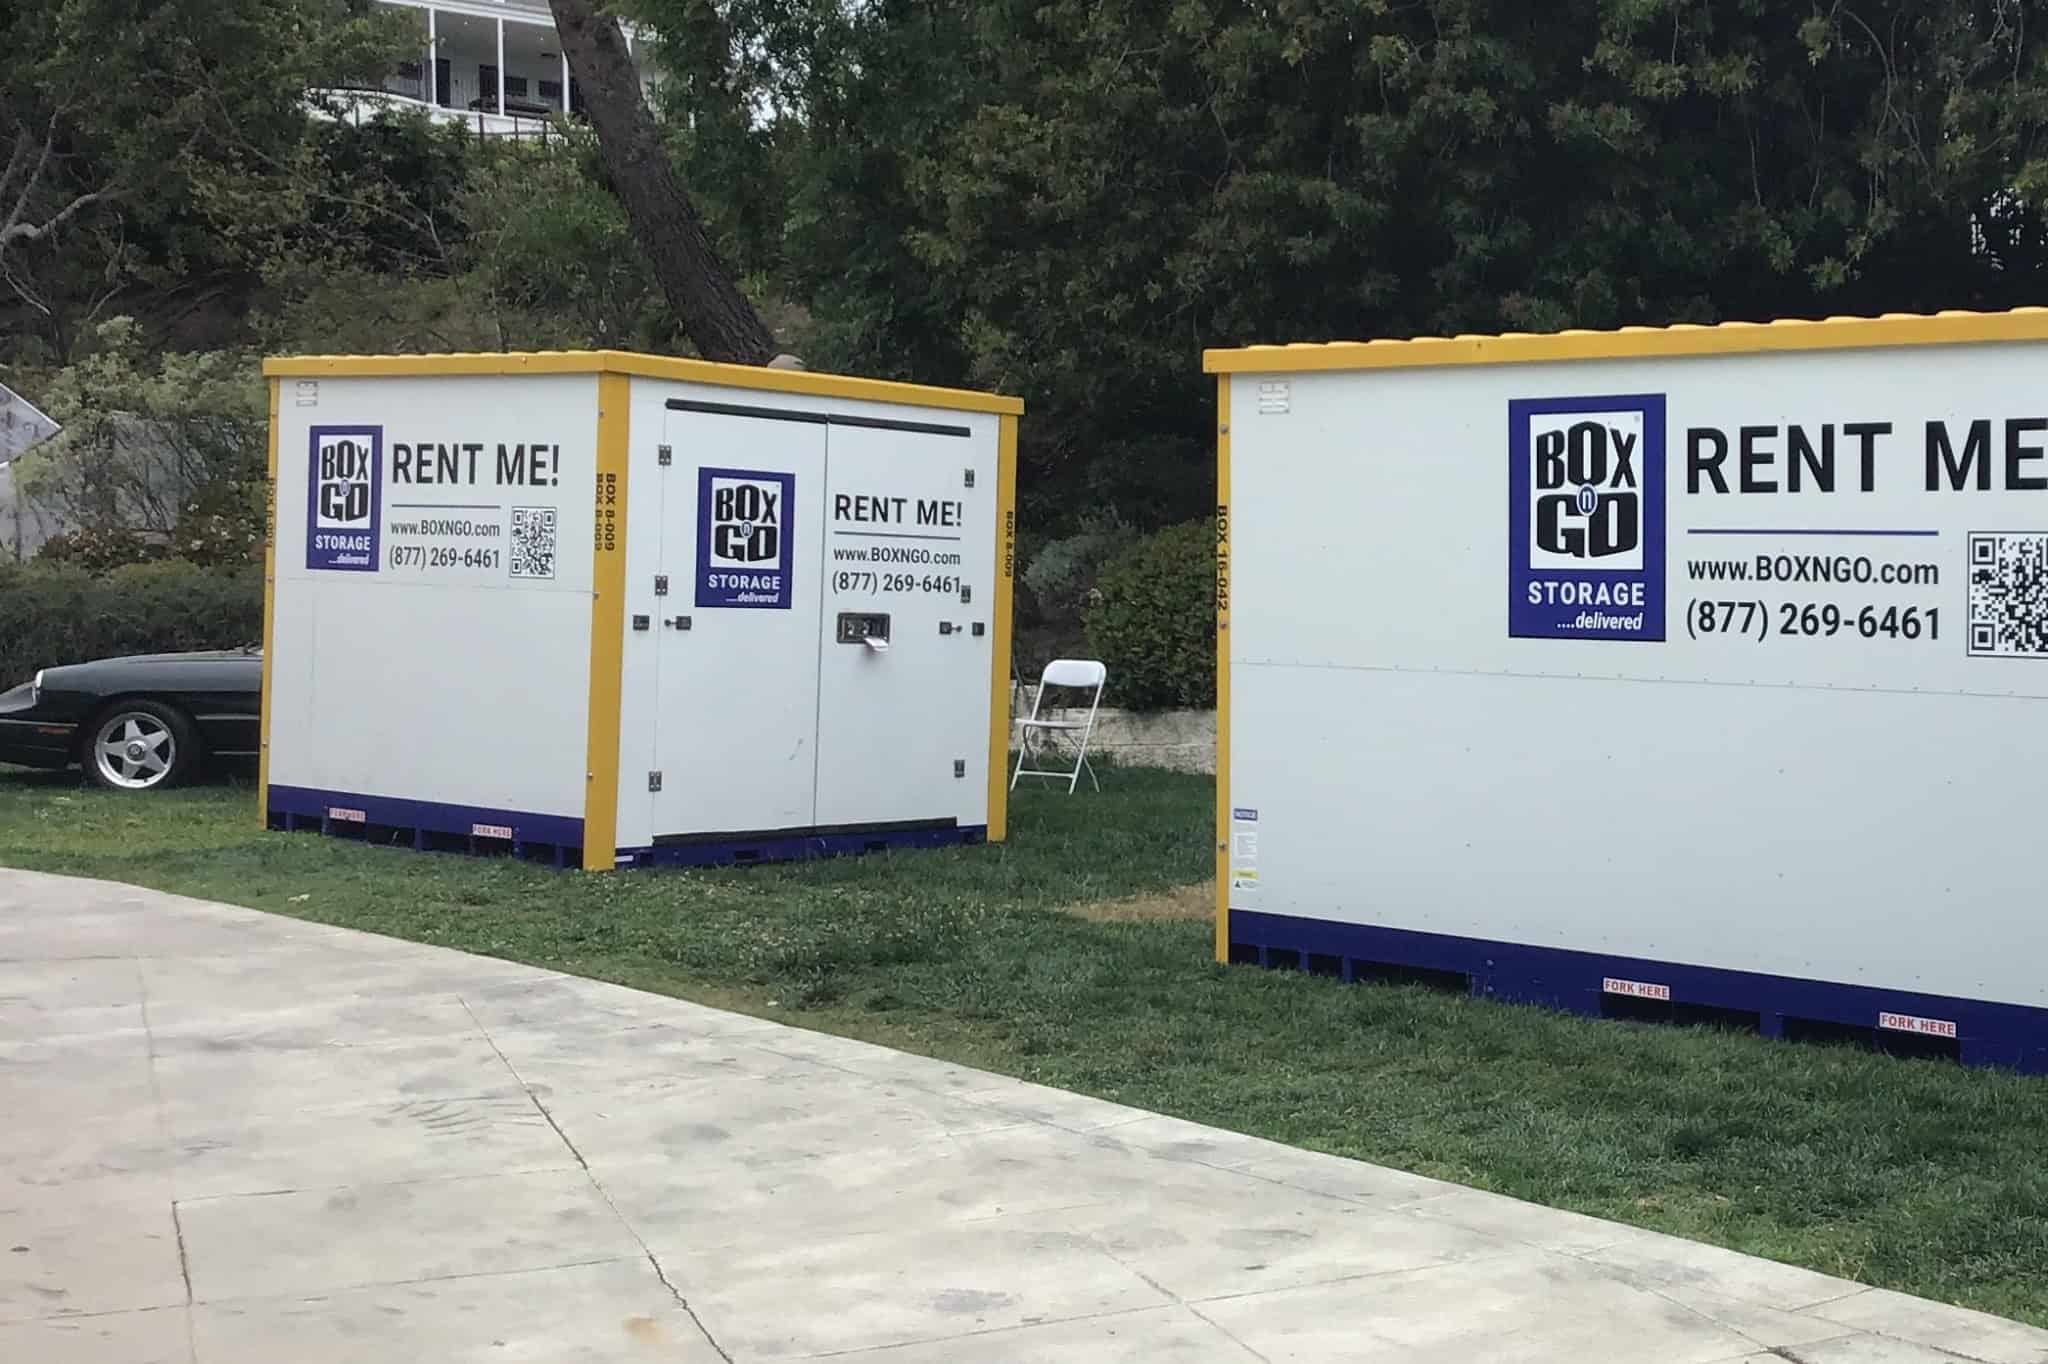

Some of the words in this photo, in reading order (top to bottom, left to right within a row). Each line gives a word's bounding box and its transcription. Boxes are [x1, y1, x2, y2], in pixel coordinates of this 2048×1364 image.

[320, 439, 369, 480] BOX
[392, 443, 484, 485] RENT
[496, 443, 560, 487] ME!
[1536, 420, 1638, 489] BOX
[1686, 421, 1892, 495] RENT
[1925, 417, 2048, 491] ME
[320, 483, 369, 522] GO
[605, 473, 617, 504] BOX
[715, 484, 777, 524] BOX
[834, 493, 908, 523] RENT
[916, 499, 963, 527] ME!
[1006, 511, 1014, 538] BOX
[1217, 504, 1228, 545] BOX
[1536, 491, 1638, 559] GO
[315, 535, 371, 551] STORAGE
[390, 519, 501, 537] www.BOXNGO.com
[604, 509, 616, 551] 8-009
[714, 524, 778, 562] GO
[389, 544, 427, 571] (877)
[430, 547, 500, 569] 269-6461
[833, 547, 961, 565] www.BOXNGO.com
[1687, 555, 1939, 585] www.BOXNGO.com
[708, 574, 782, 590] STORAGE
[832, 570, 878, 595] (877)
[883, 573, 960, 593] 269-6461
[1527, 580, 1645, 606] STORAGE
[1686, 598, 1769, 643] (877)
[1779, 602, 1940, 640] 269-6461
[1604, 979, 1633, 993] FORK
[1639, 983, 1669, 999] HERE
[1881, 1014, 1914, 1030] FORK
[1920, 1019, 1955, 1036] HERE
